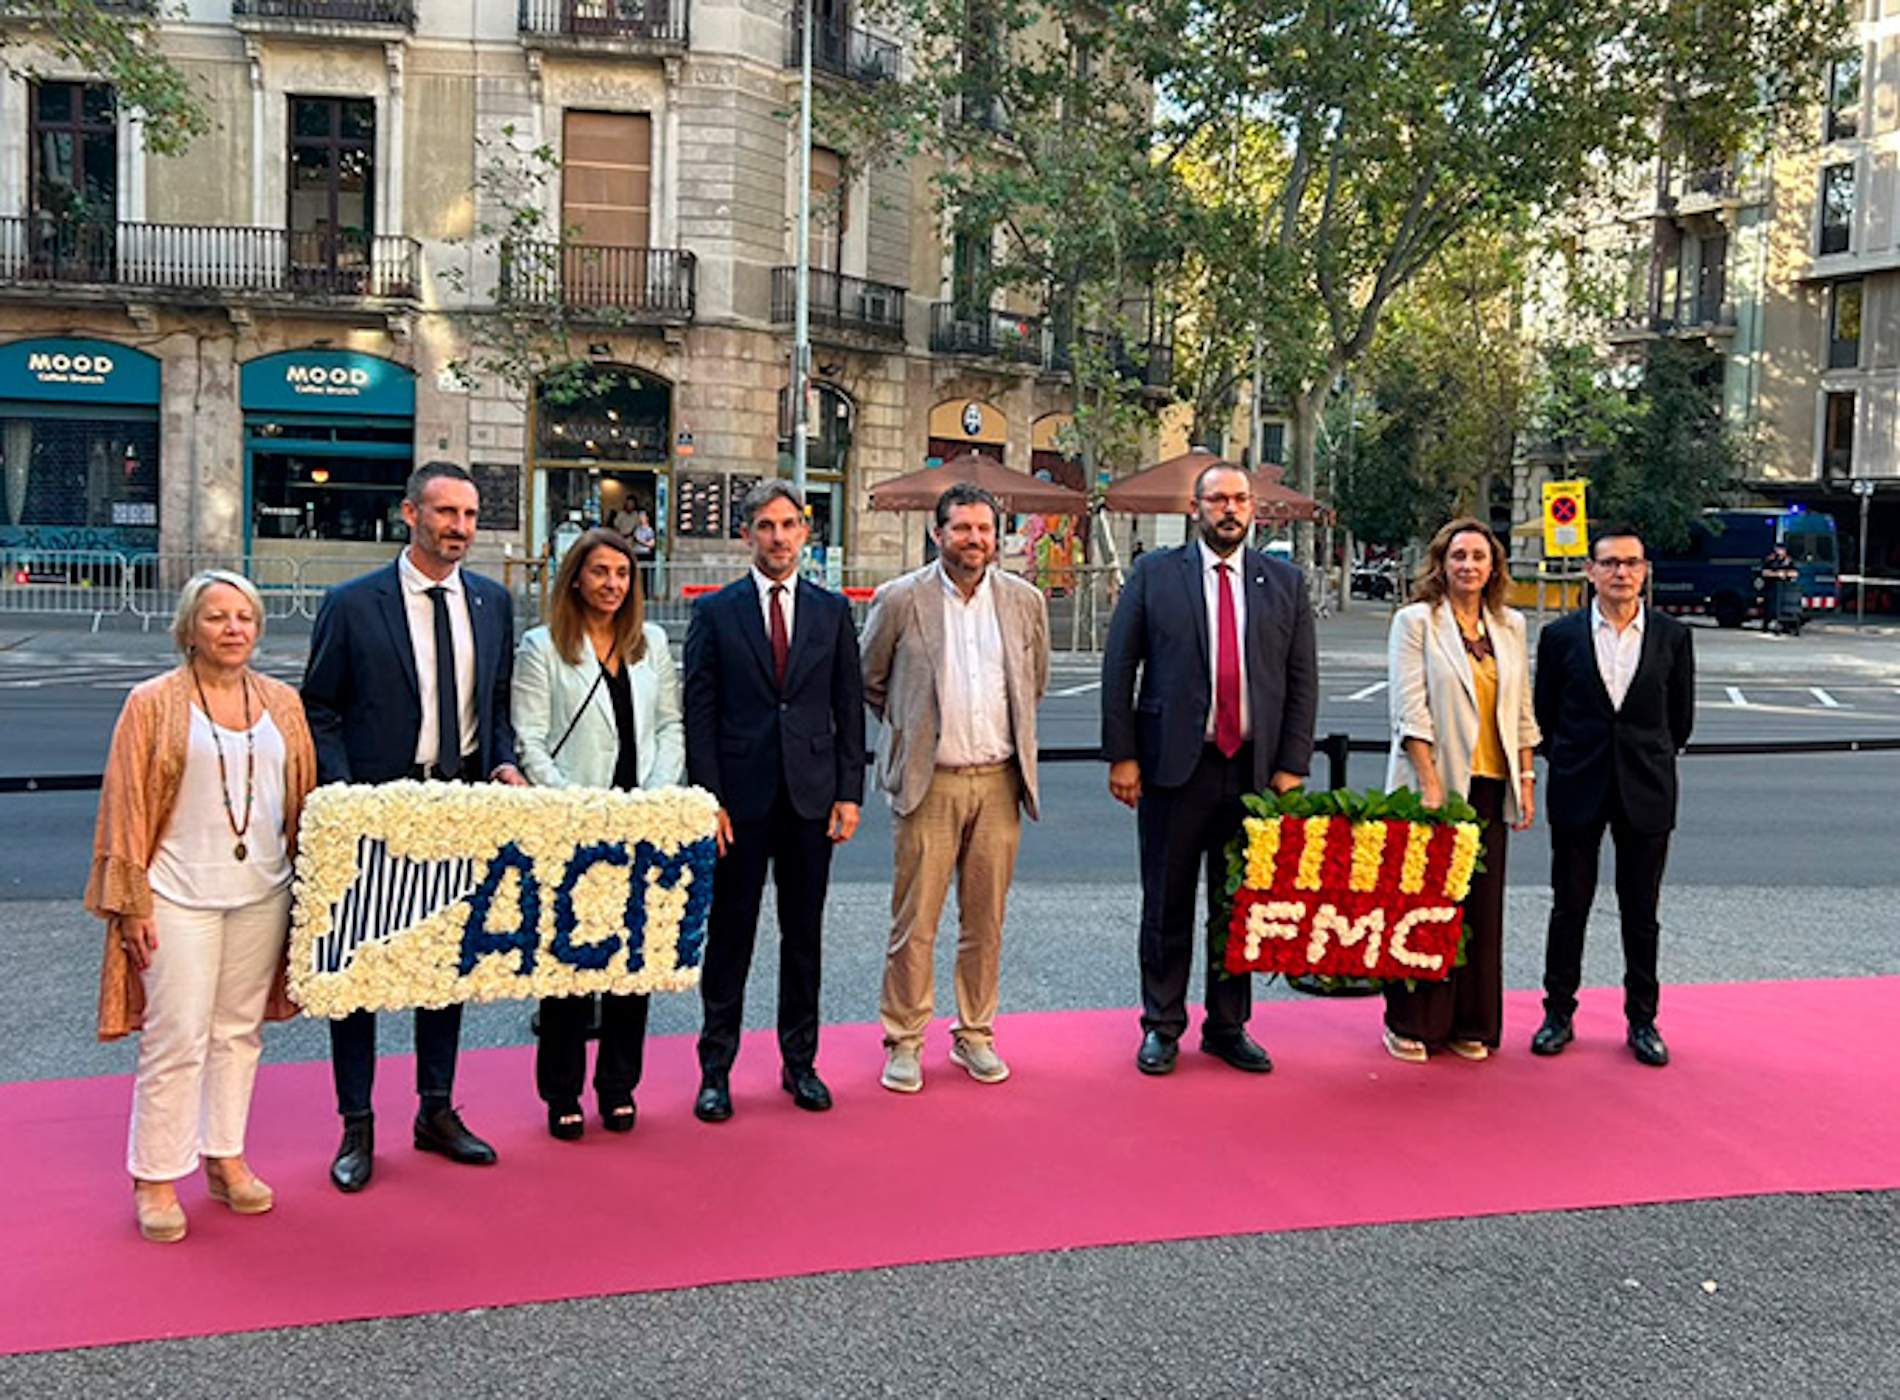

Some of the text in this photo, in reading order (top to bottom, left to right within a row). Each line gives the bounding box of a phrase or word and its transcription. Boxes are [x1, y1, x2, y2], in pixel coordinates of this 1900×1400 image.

[28, 353, 114, 374] MOOD
[286, 365, 369, 386] MOOD
[457, 837, 717, 976] ACM
[1243, 900, 1457, 970] FMC
